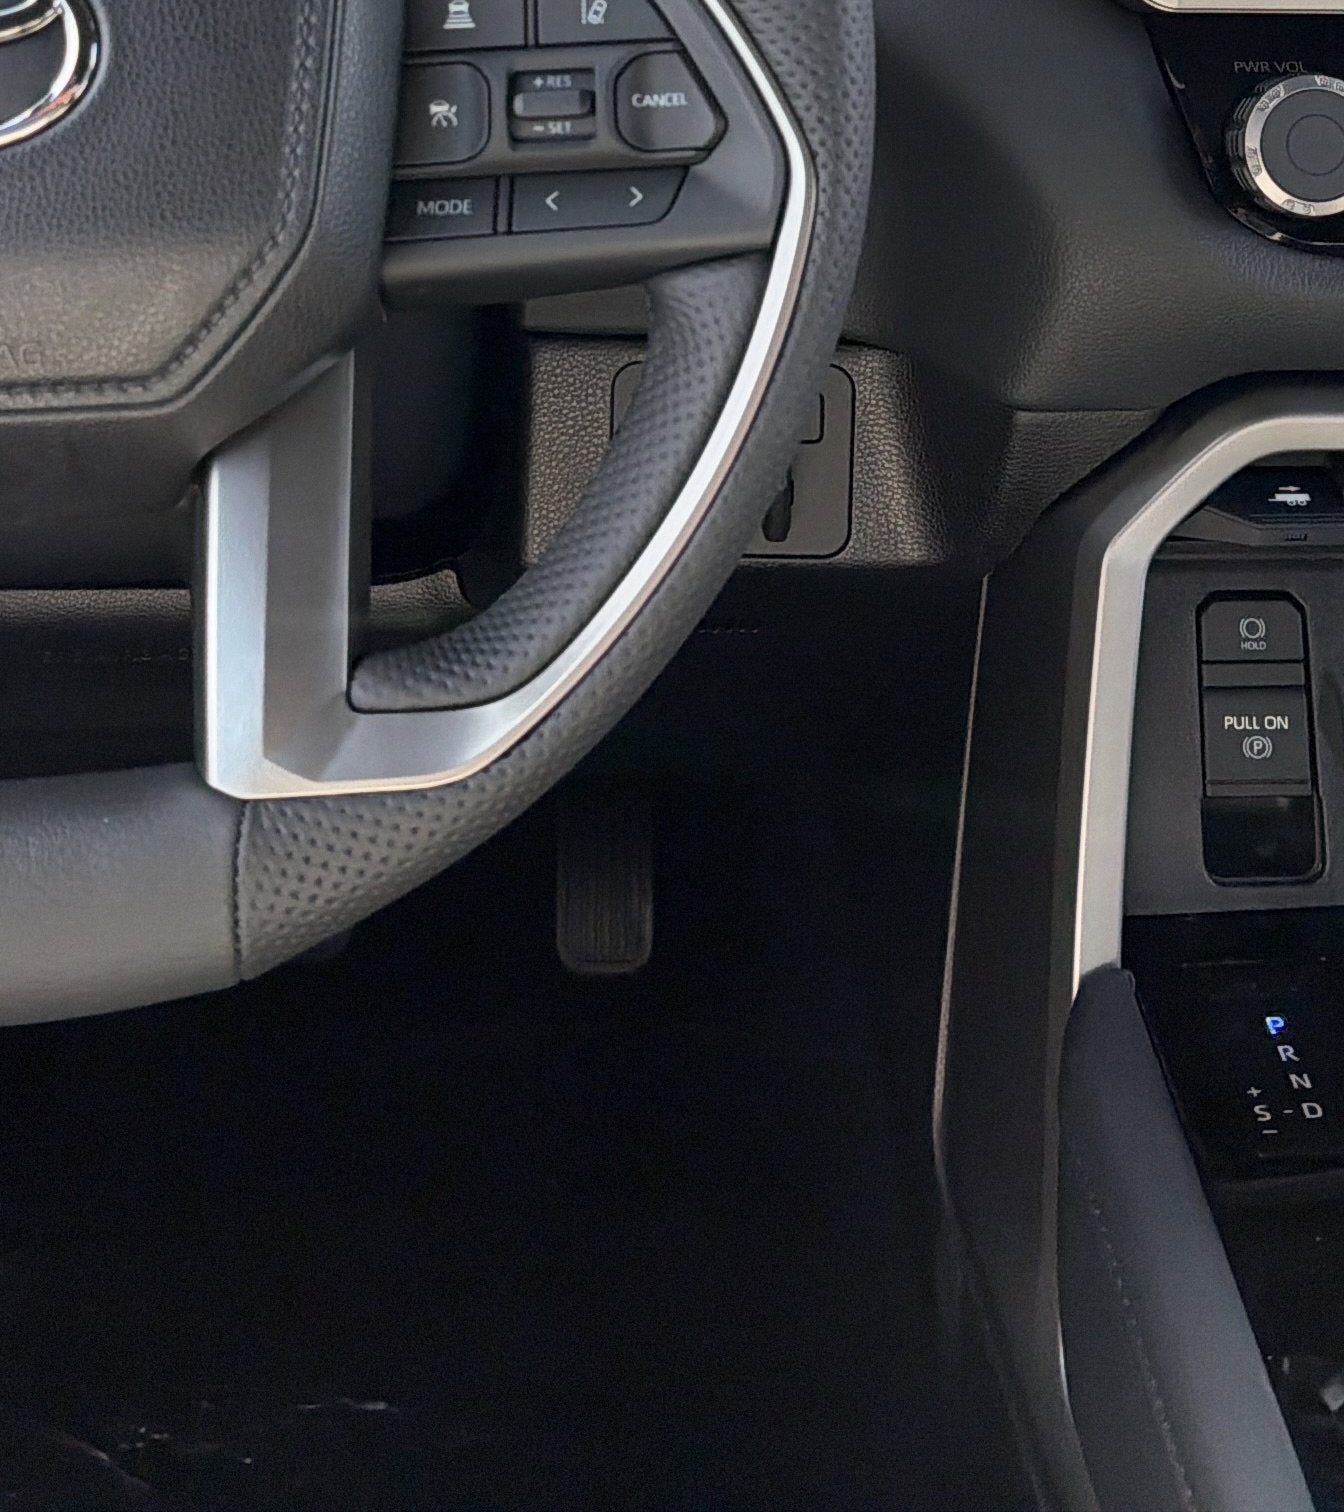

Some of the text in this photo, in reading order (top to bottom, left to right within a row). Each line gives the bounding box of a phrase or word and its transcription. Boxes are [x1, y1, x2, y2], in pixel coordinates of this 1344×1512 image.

[1233, 61, 1308, 74] PWR VOL
[632, 93, 688, 108] CANCEL
[417, 200, 473, 217] MODE
[1241, 640, 1266, 650] HOLD
[1224, 715, 1289, 730] PULL ON
[1265, 1016, 1285, 1035] P
[1277, 1045, 1300, 1062] R
[1289, 1073, 1312, 1089] N
[1254, 1102, 1323, 1122] S D
